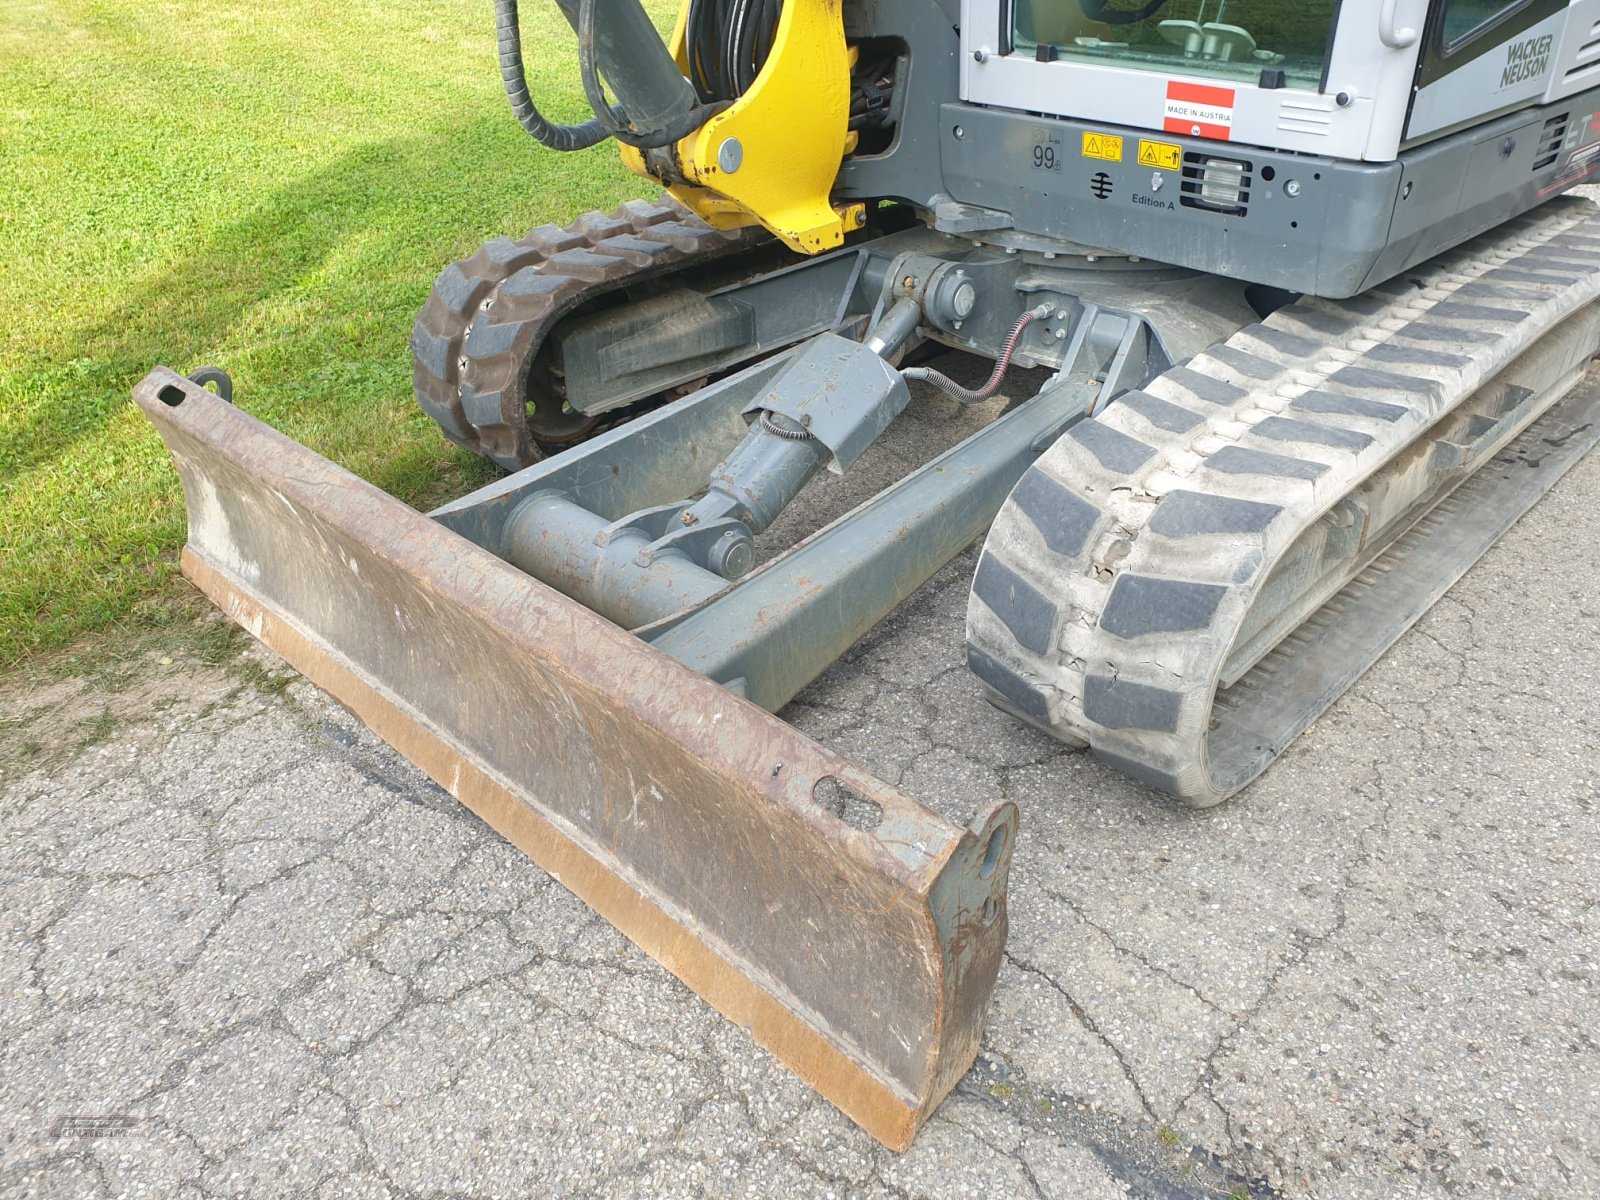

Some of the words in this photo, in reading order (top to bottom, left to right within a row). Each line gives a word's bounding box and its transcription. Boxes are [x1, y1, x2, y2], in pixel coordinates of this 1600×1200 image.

[1507, 34, 1553, 65] WACKER
[1499, 54, 1549, 88] NEUSON
[1167, 105, 1188, 116] MADE
[1190, 109, 1198, 117] IN
[1199, 111, 1231, 122] AUSTRIA
[1033, 145, 1055, 169] 99
[1132, 193, 1165, 208] Edition
[1167, 201, 1175, 211] A
